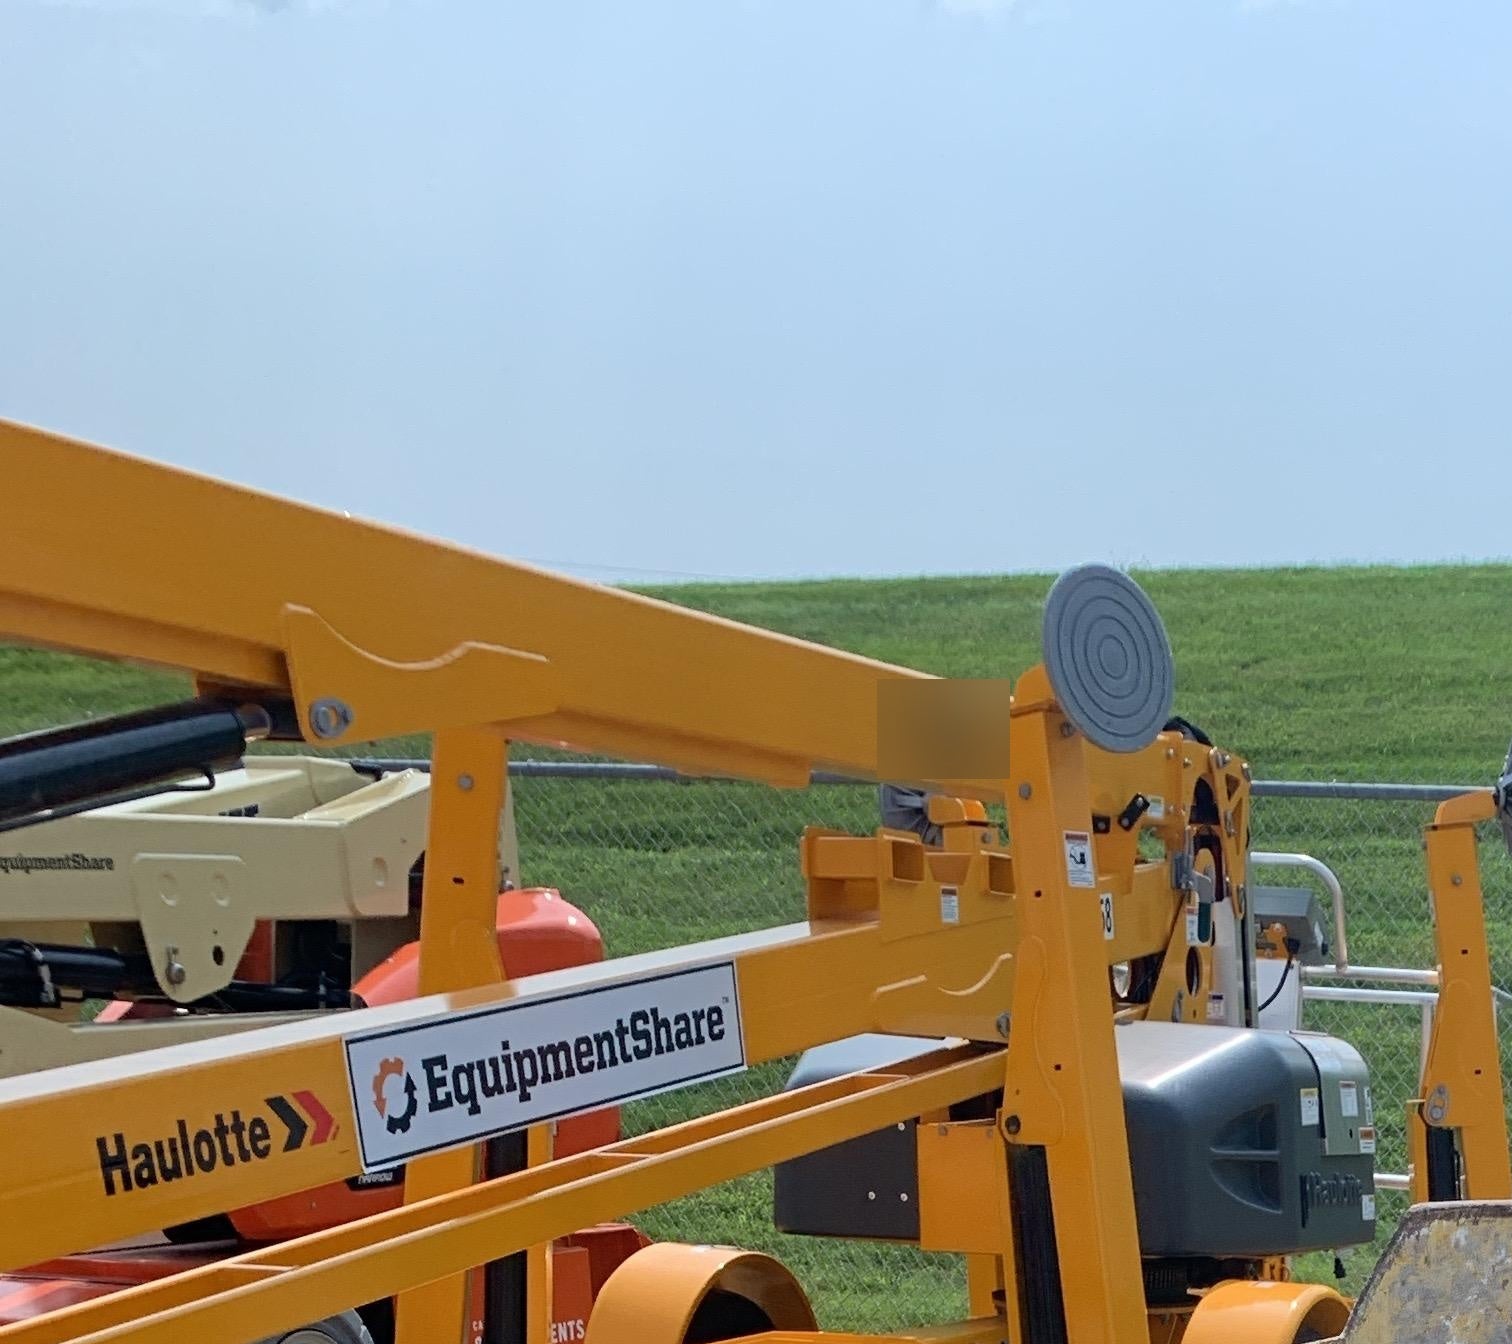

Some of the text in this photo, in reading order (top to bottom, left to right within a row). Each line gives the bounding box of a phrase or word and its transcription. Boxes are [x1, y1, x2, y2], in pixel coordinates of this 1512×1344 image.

[0, 853, 114, 874] quipmentShare
[421, 1006, 726, 1117] EquipmentShare
[96, 1109, 272, 1196] Haulotte
[551, 1319, 585, 1344] ENTS
